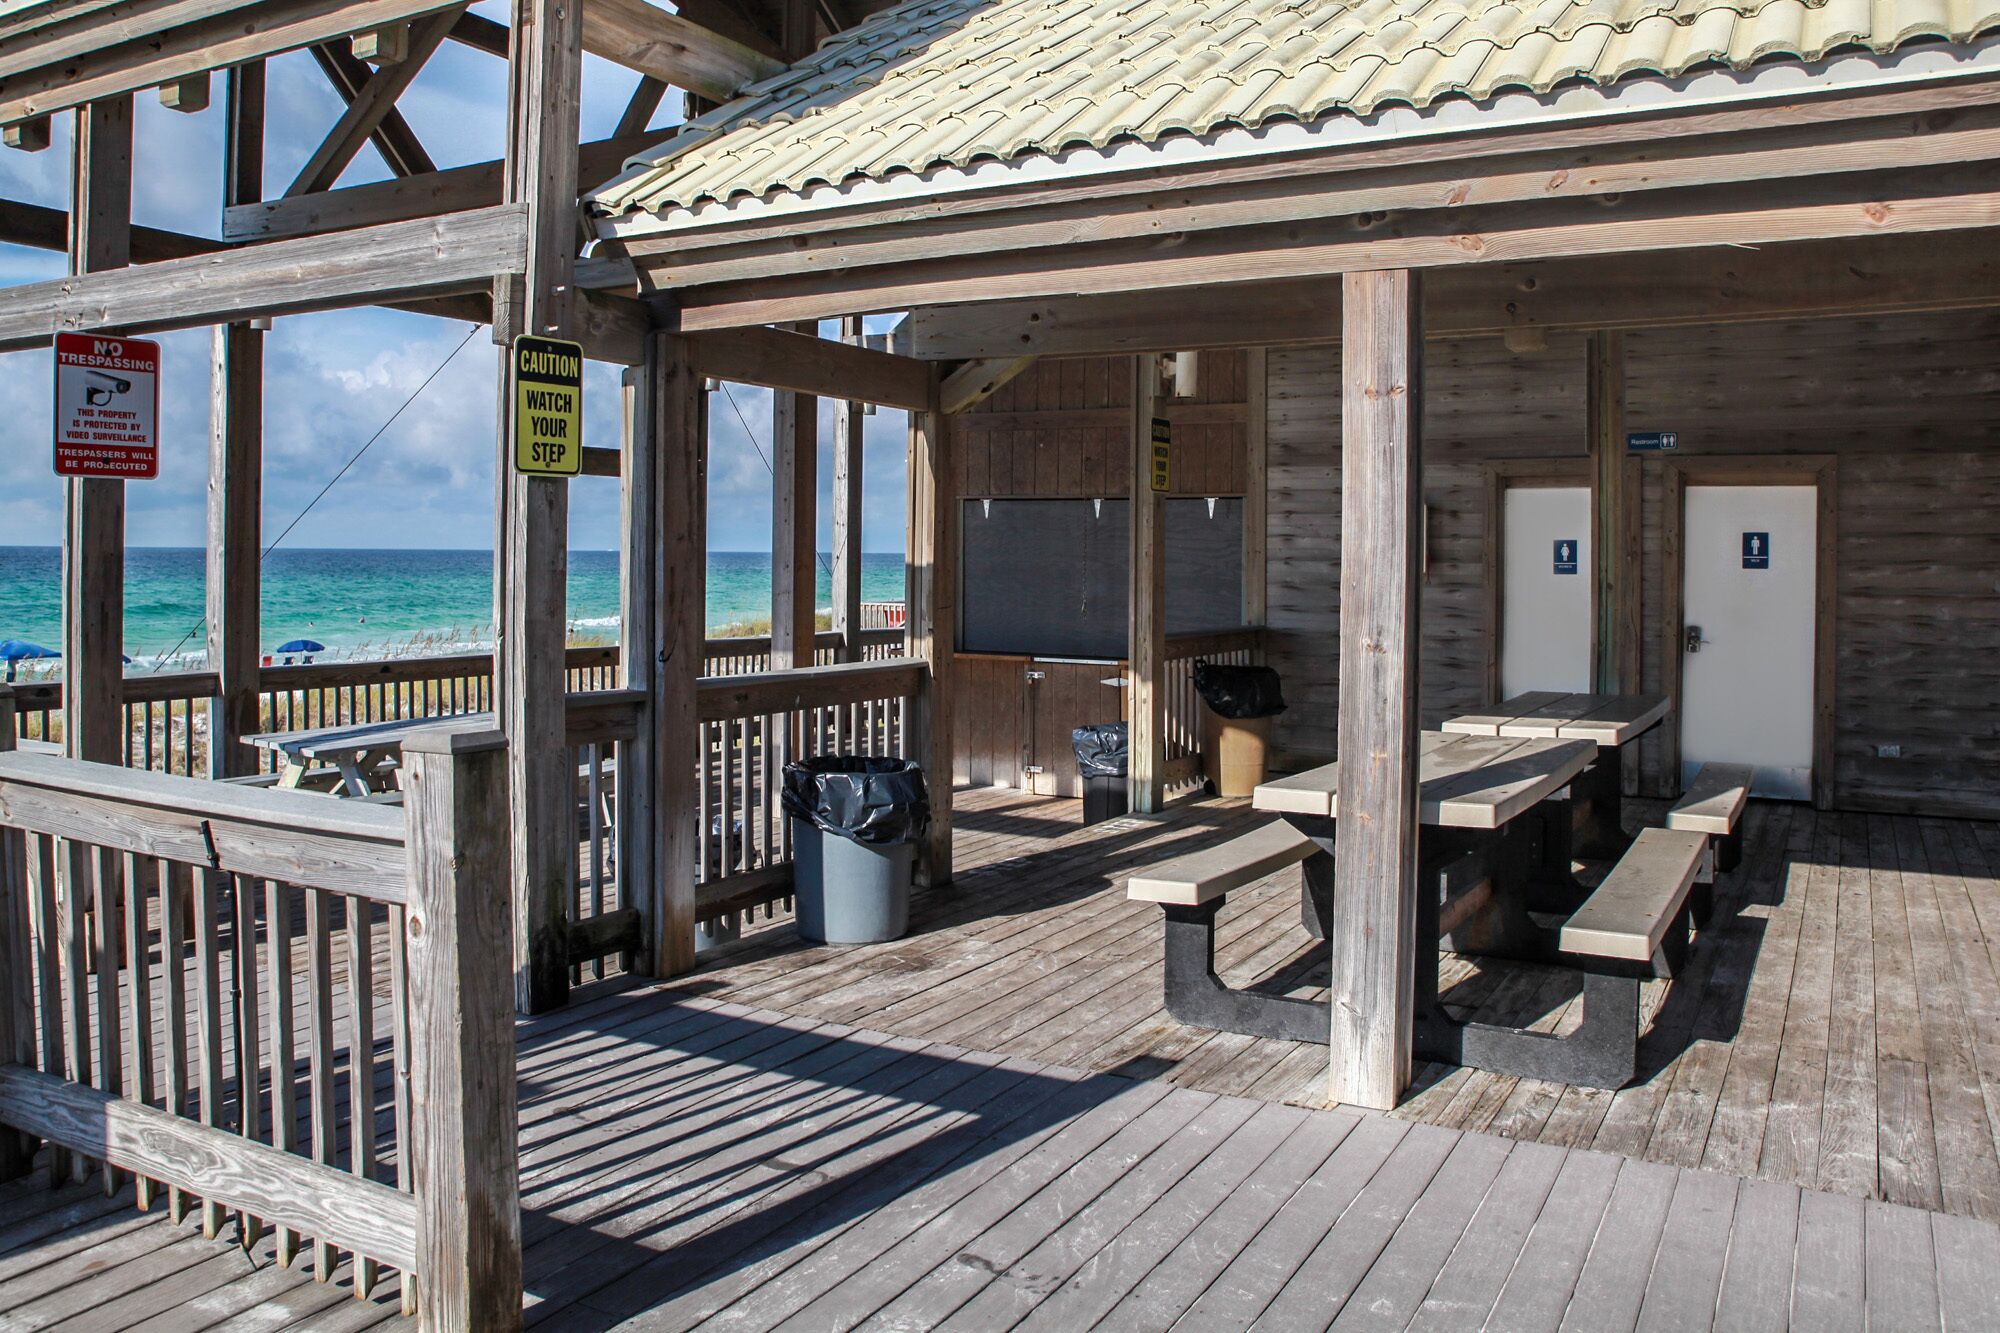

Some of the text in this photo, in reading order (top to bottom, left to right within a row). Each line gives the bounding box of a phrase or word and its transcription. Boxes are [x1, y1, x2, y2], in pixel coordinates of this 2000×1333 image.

[94, 340, 123, 357] NO
[59, 352, 154, 371] TRESPASSING
[520, 350, 578, 378] CAUTION
[526, 389, 572, 414] WATCH
[77, 408, 137, 420] THIS PROPERTY
[72, 419, 141, 431] IS PROTECTED BY
[531, 415, 567, 438] YOUR
[66, 431, 147, 443] VIDEO SURVEILLANCE
[58, 448, 154, 460] TRESPASSERS WILL
[532, 442, 566, 463] STEP
[65, 460, 79, 468] BE
